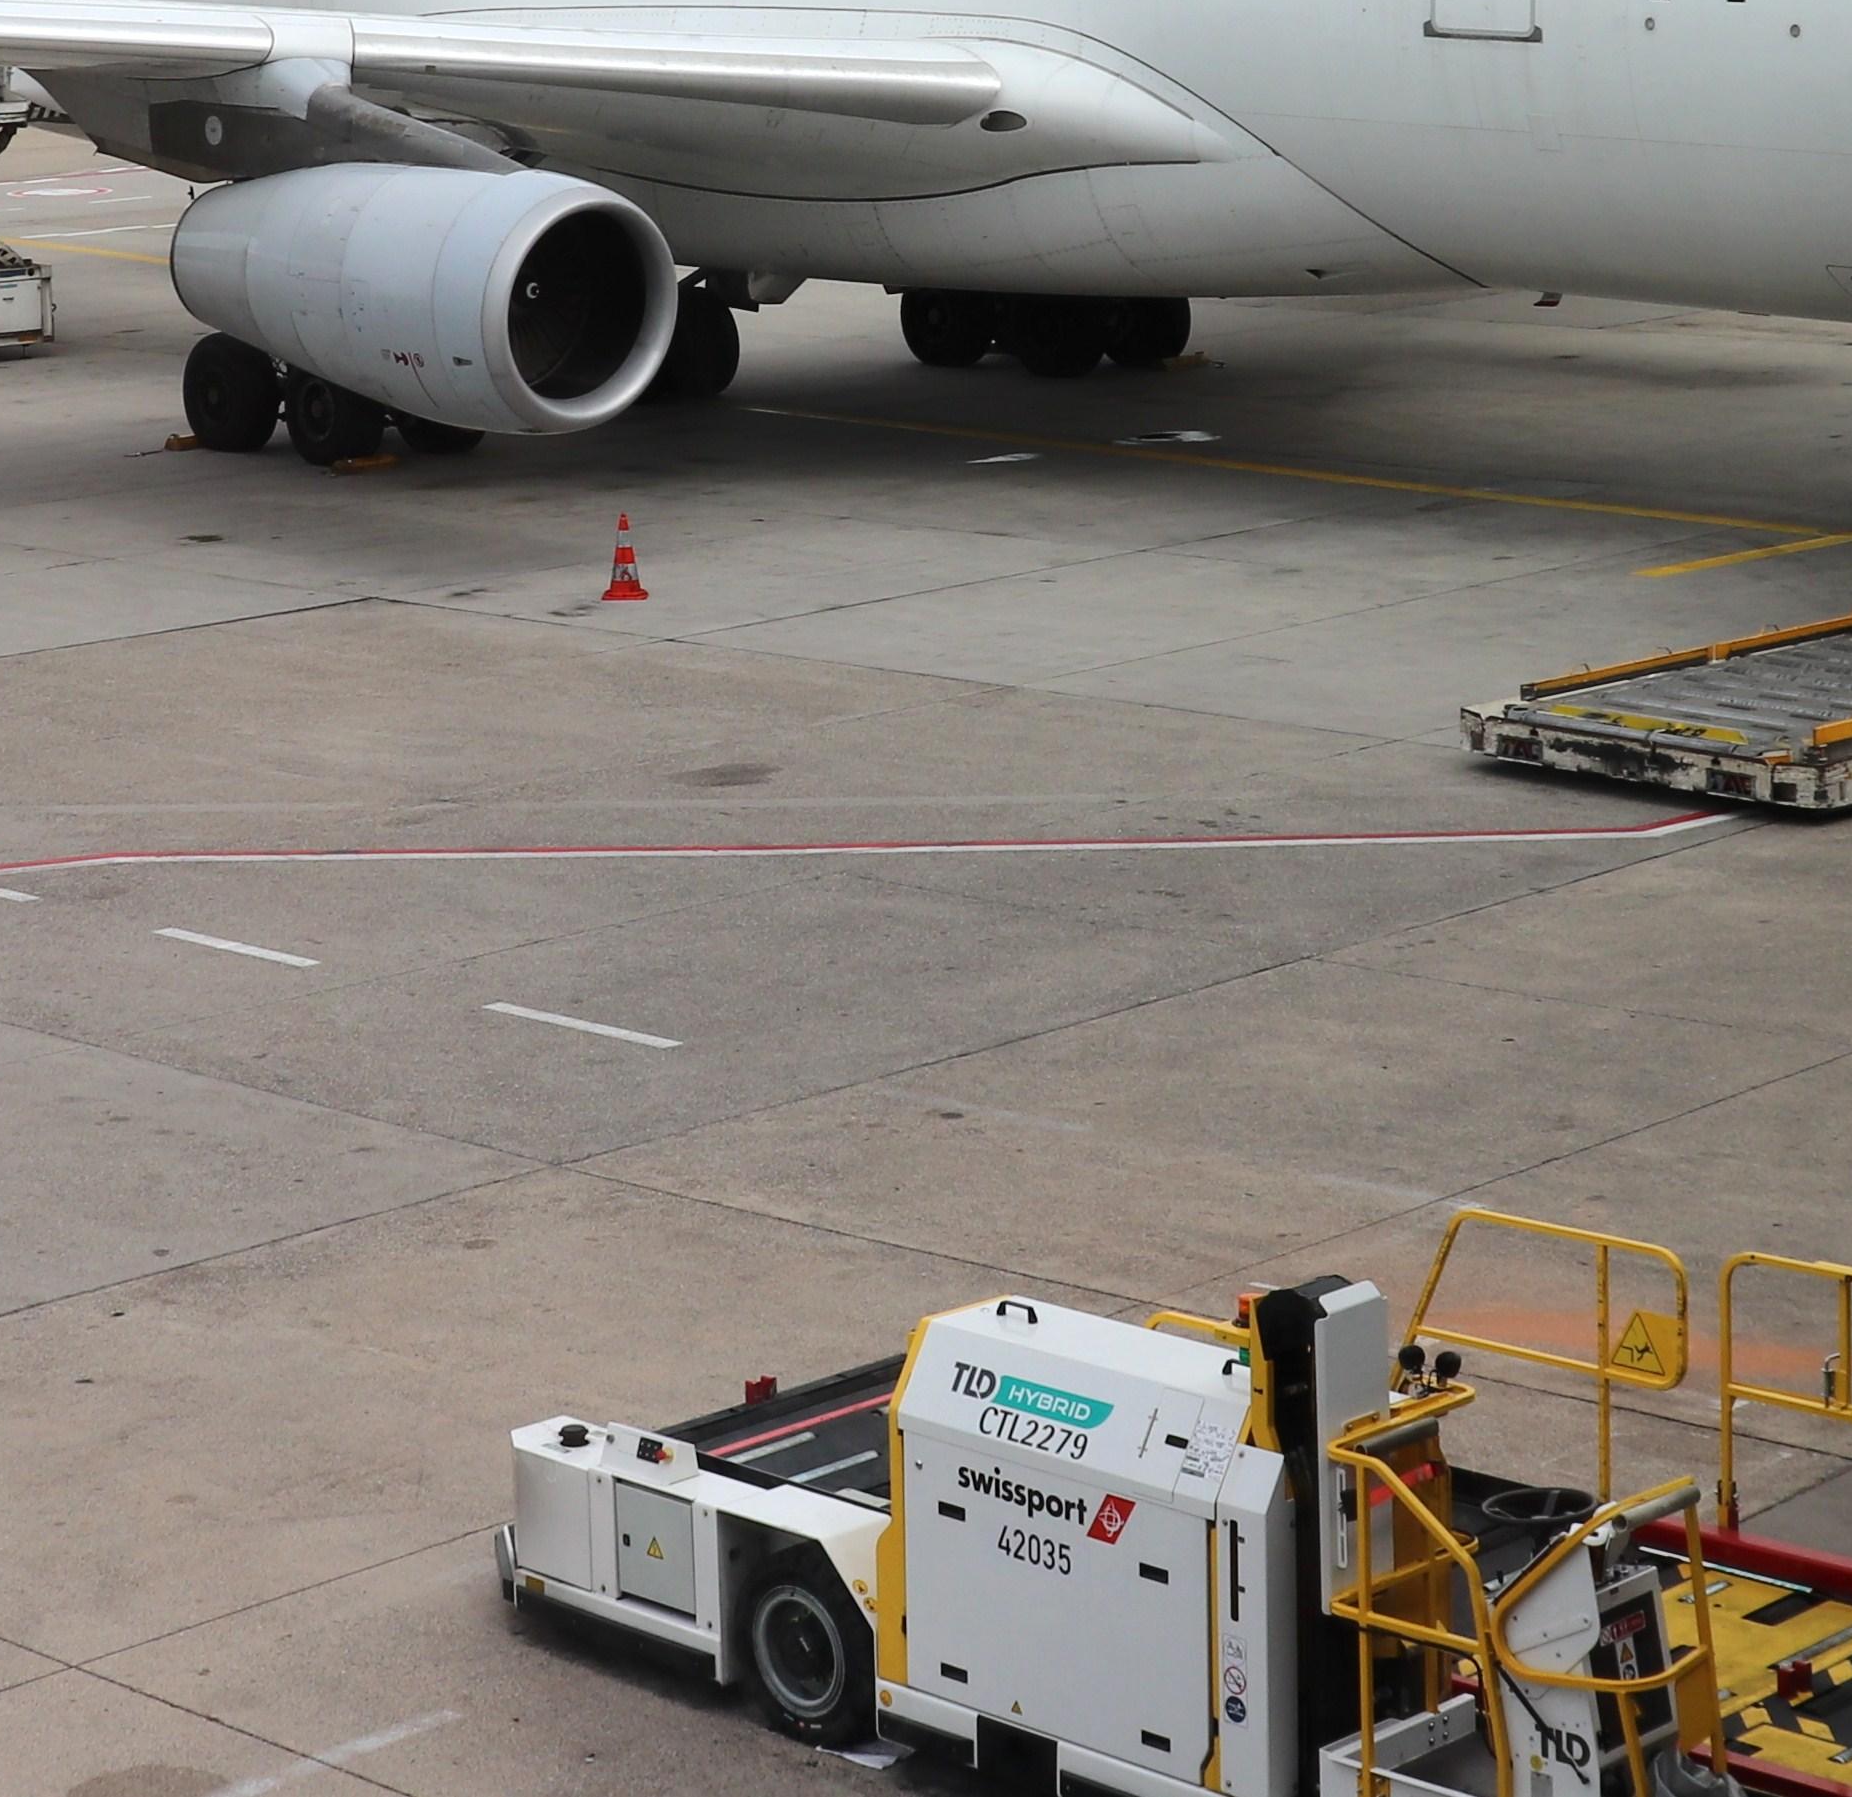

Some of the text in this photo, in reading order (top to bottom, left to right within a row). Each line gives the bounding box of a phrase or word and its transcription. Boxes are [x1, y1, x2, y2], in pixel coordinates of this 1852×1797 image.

[951, 1361, 1092, 1421] TLD HYBRID
[979, 1406, 1089, 1460] CTL2279
[958, 1466, 1088, 1526] swissport
[997, 1525, 1072, 1576] 42035
[1534, 1723, 1591, 1768] TLD
